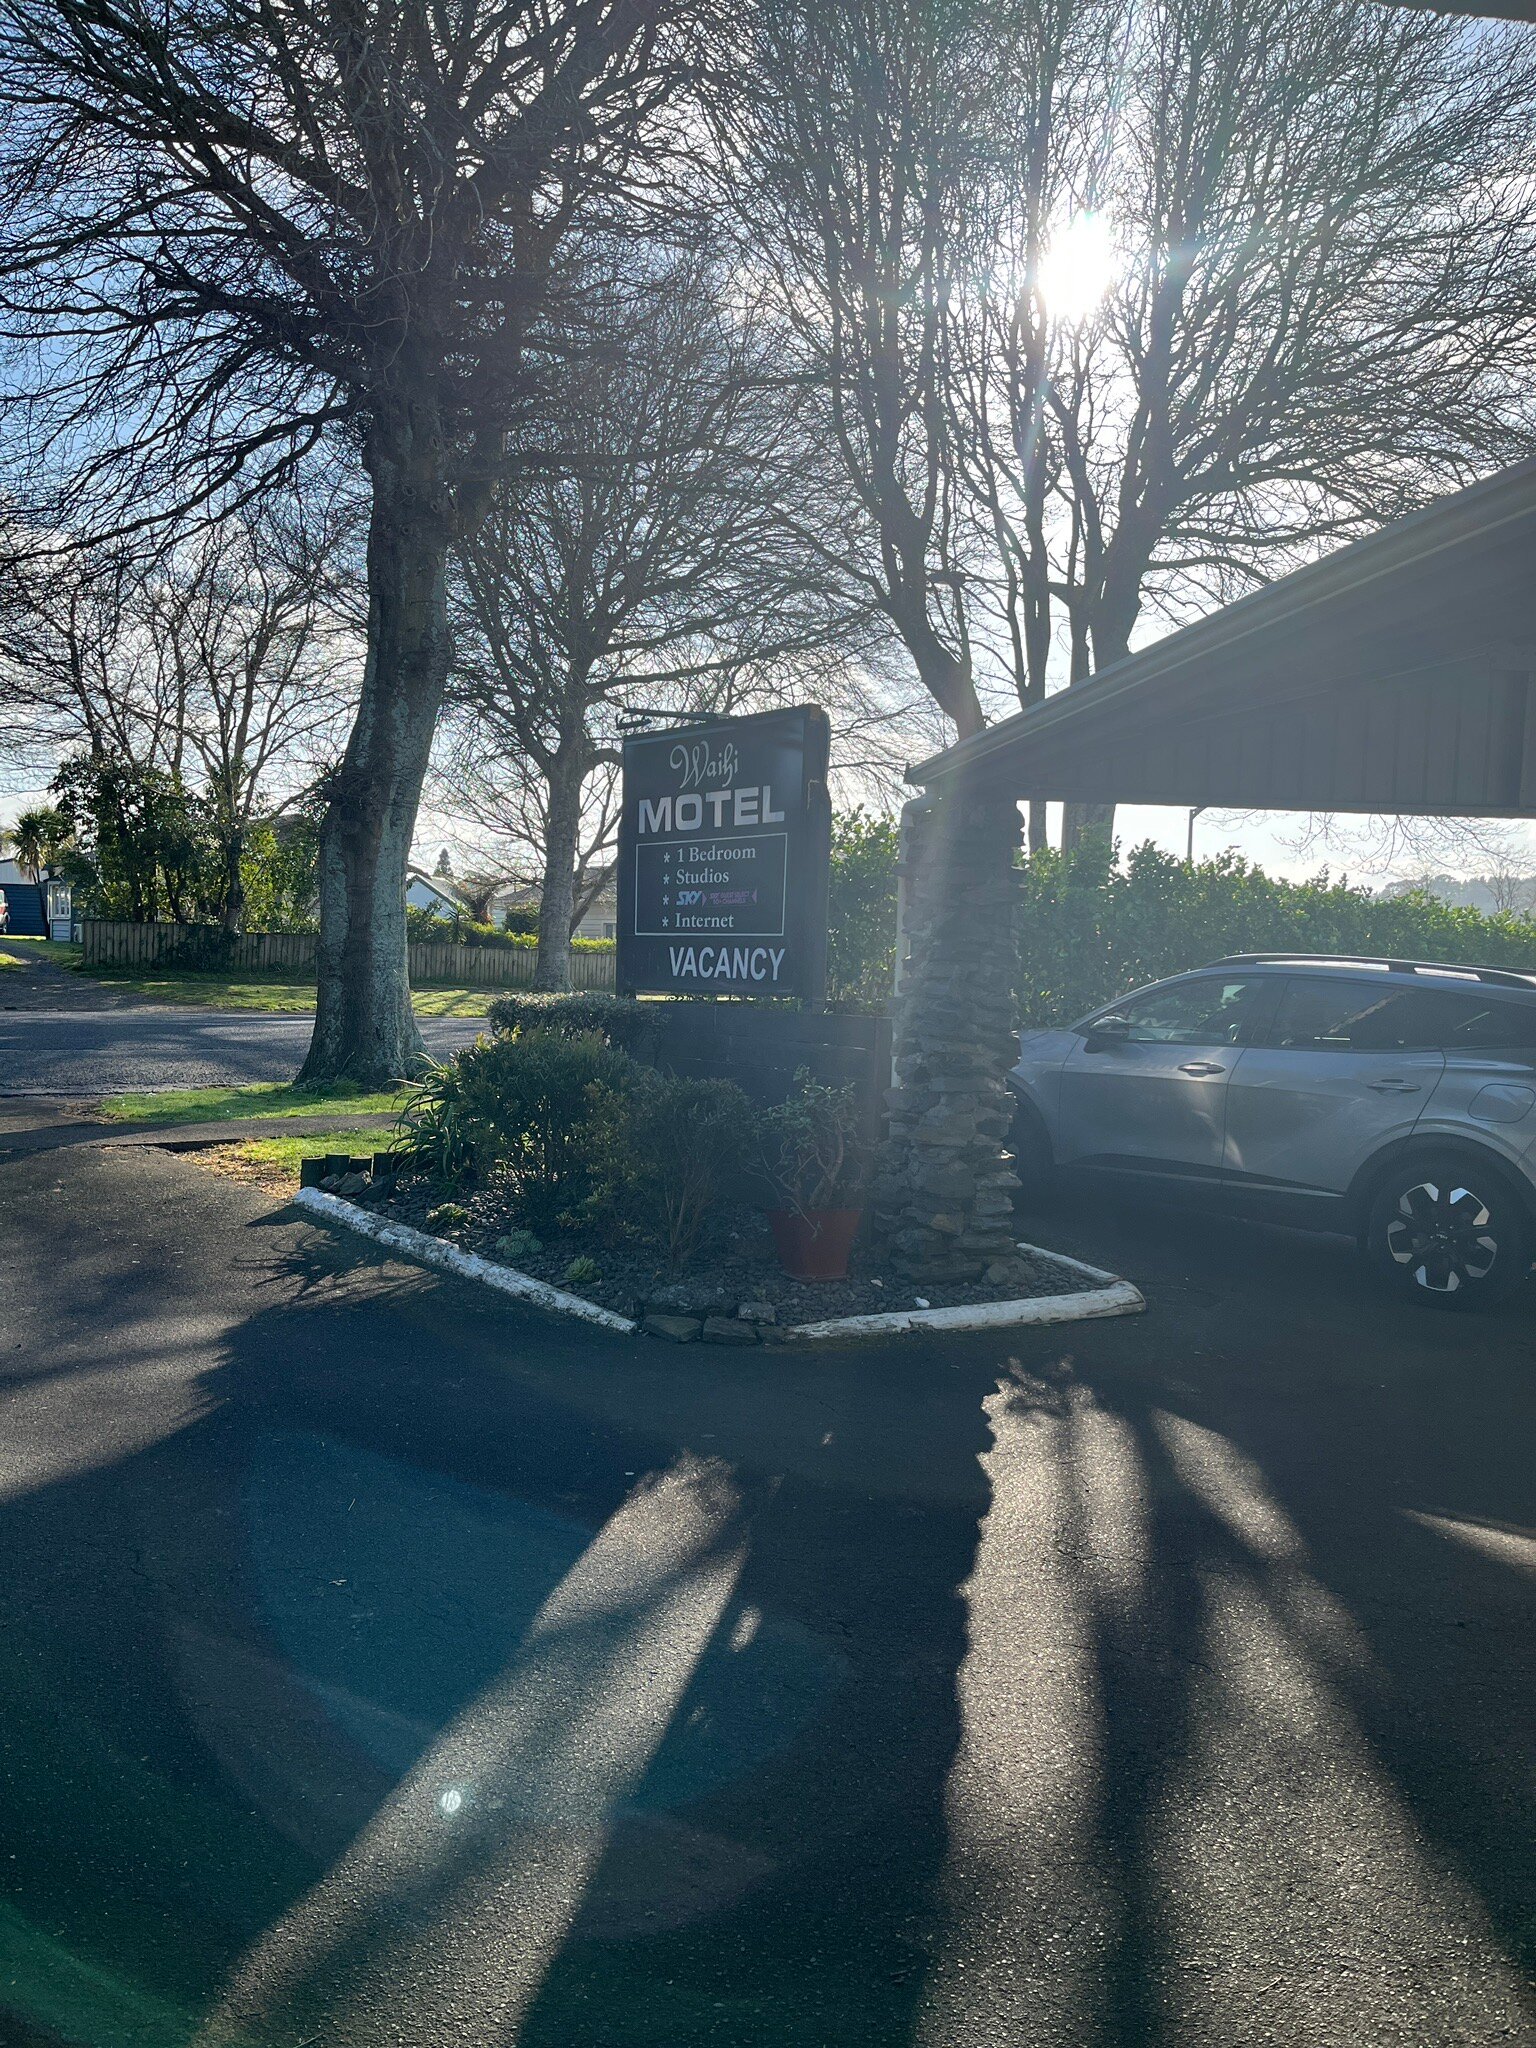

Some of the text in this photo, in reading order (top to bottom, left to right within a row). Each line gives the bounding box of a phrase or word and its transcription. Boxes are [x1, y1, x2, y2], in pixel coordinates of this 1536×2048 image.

[669, 740, 738, 789] Waihi
[638, 785, 785, 834] MOTEL
[677, 845, 756, 863] 1 Bedroom
[676, 868, 730, 885] Studios
[676, 890, 702, 906] SKY
[675, 913, 735, 928] Internet
[669, 946, 786, 981] VACANCY
